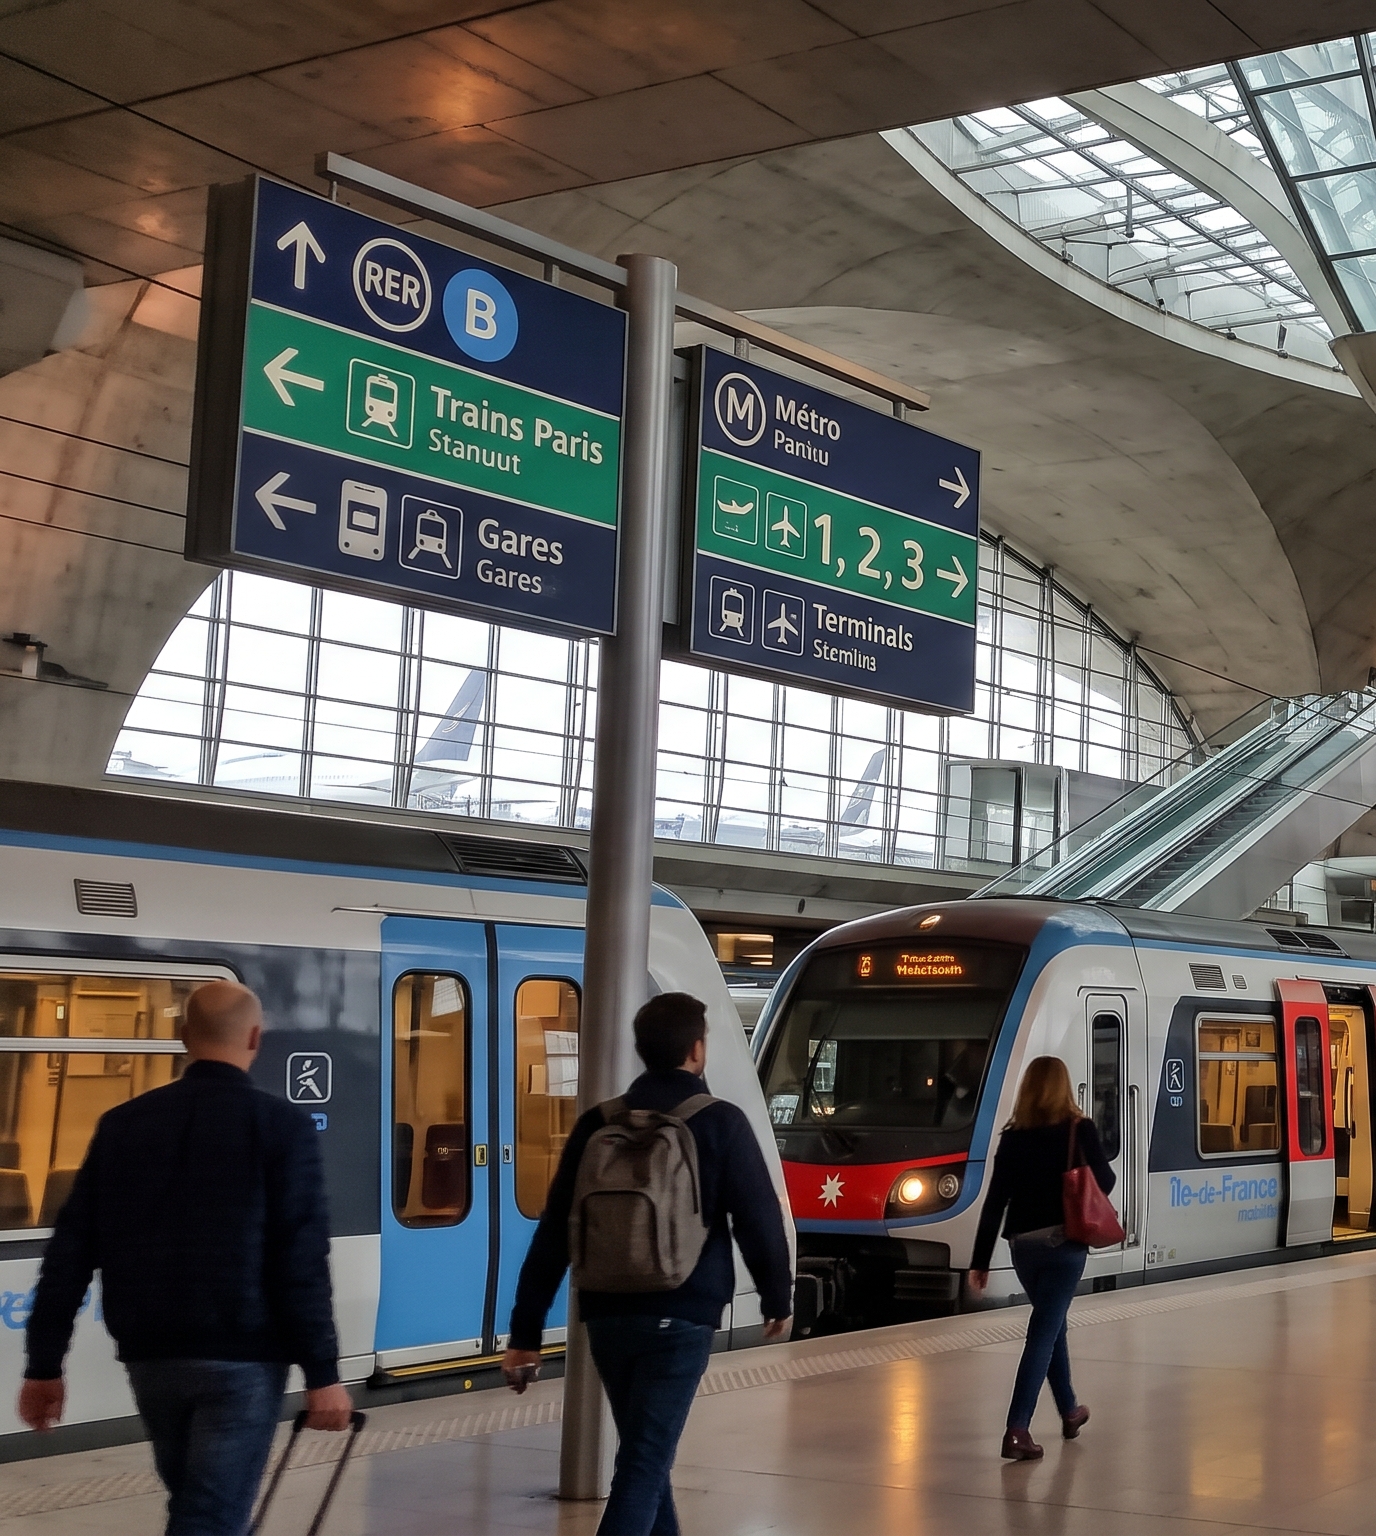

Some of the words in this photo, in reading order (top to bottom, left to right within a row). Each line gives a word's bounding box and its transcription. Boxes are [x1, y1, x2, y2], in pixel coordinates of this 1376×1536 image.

[365, 260, 421, 309] RER
[465, 288, 497, 340] B
[430, 385, 524, 441] Trains
[534, 418, 603, 465] Paris
[727, 386, 755, 431] M
[775, 395, 841, 441] Métro
[428, 429, 521, 475] Stanuut
[478, 519, 563, 565] Gares
[477, 559, 542, 594] Gares
[812, 603, 914, 652] Terminals
